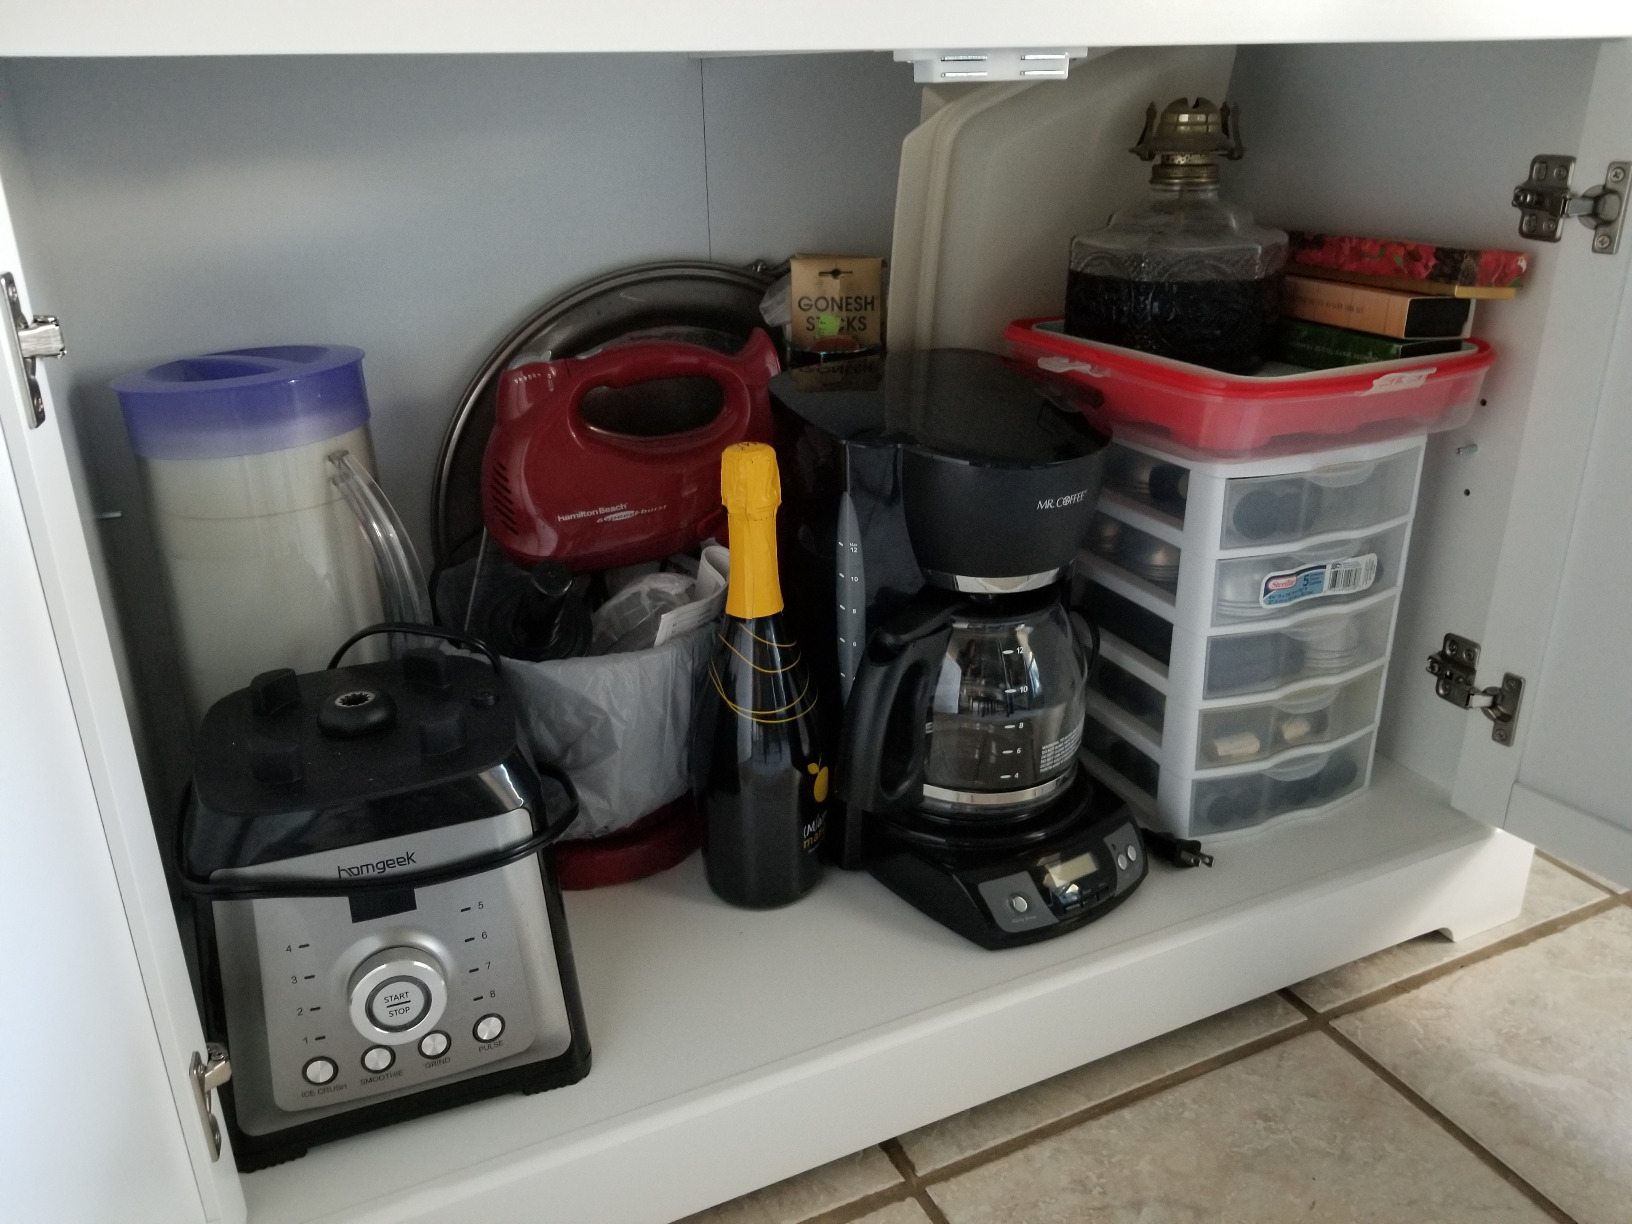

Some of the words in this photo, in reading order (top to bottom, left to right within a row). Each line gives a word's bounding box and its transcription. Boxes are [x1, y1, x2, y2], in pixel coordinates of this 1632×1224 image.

[798, 296, 875, 312] GONESH
[806, 316, 867, 331] SKS
[1036, 499, 1055, 510] MR.
[557, 509, 599, 521] Hamilton
[599, 503, 627, 514] Beach
[1303, 574, 1309, 587] 5
[1019, 686, 1028, 694] 10
[478, 902, 484, 910] 5
[481, 931, 488, 940] 6
[285, 944, 293, 953] 4
[485, 962, 492, 970] 7
[291, 976, 298, 984] 3
[383, 991, 410, 1004] START
[489, 990, 496, 998] 8
[297, 1007, 304, 1016] 2
[388, 1006, 411, 1018] STOP
[303, 1037, 308, 1045] 1
[478, 1040, 504, 1052] PULSE
[425, 1057, 451, 1069] GRIND
[361, 1069, 403, 1086] SMOOTHIE
[301, 1090, 316, 1098] ICE
[317, 1083, 347, 1096] CRUSH
